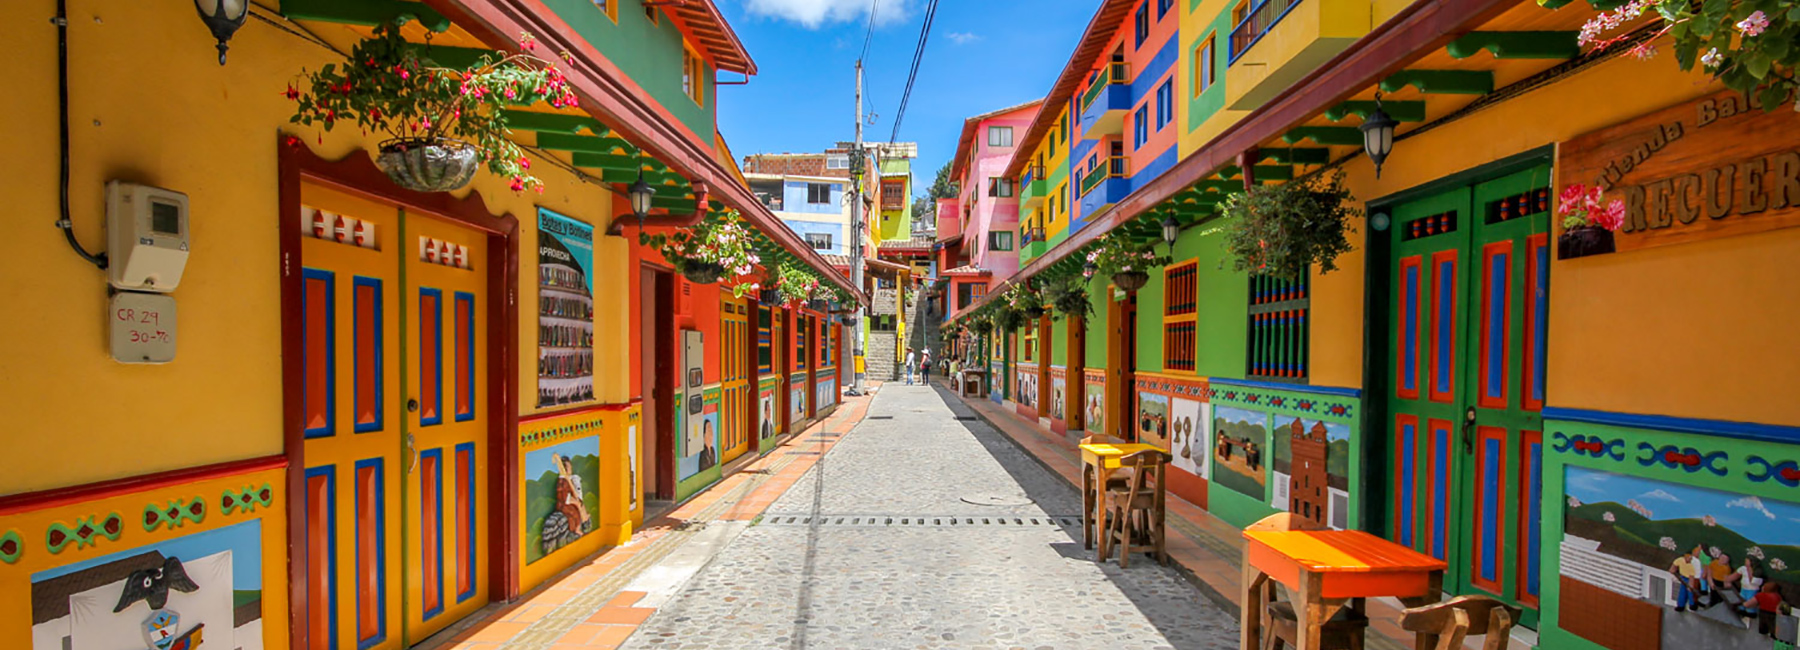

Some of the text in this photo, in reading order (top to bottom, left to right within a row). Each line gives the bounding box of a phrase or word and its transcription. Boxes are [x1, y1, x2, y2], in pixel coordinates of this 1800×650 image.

[1595, 121, 1683, 191] Tienda
[1622, 152, 1800, 233] RECUER
[541, 213, 563, 232] Botas
[117, 308, 159, 326] CR 29
